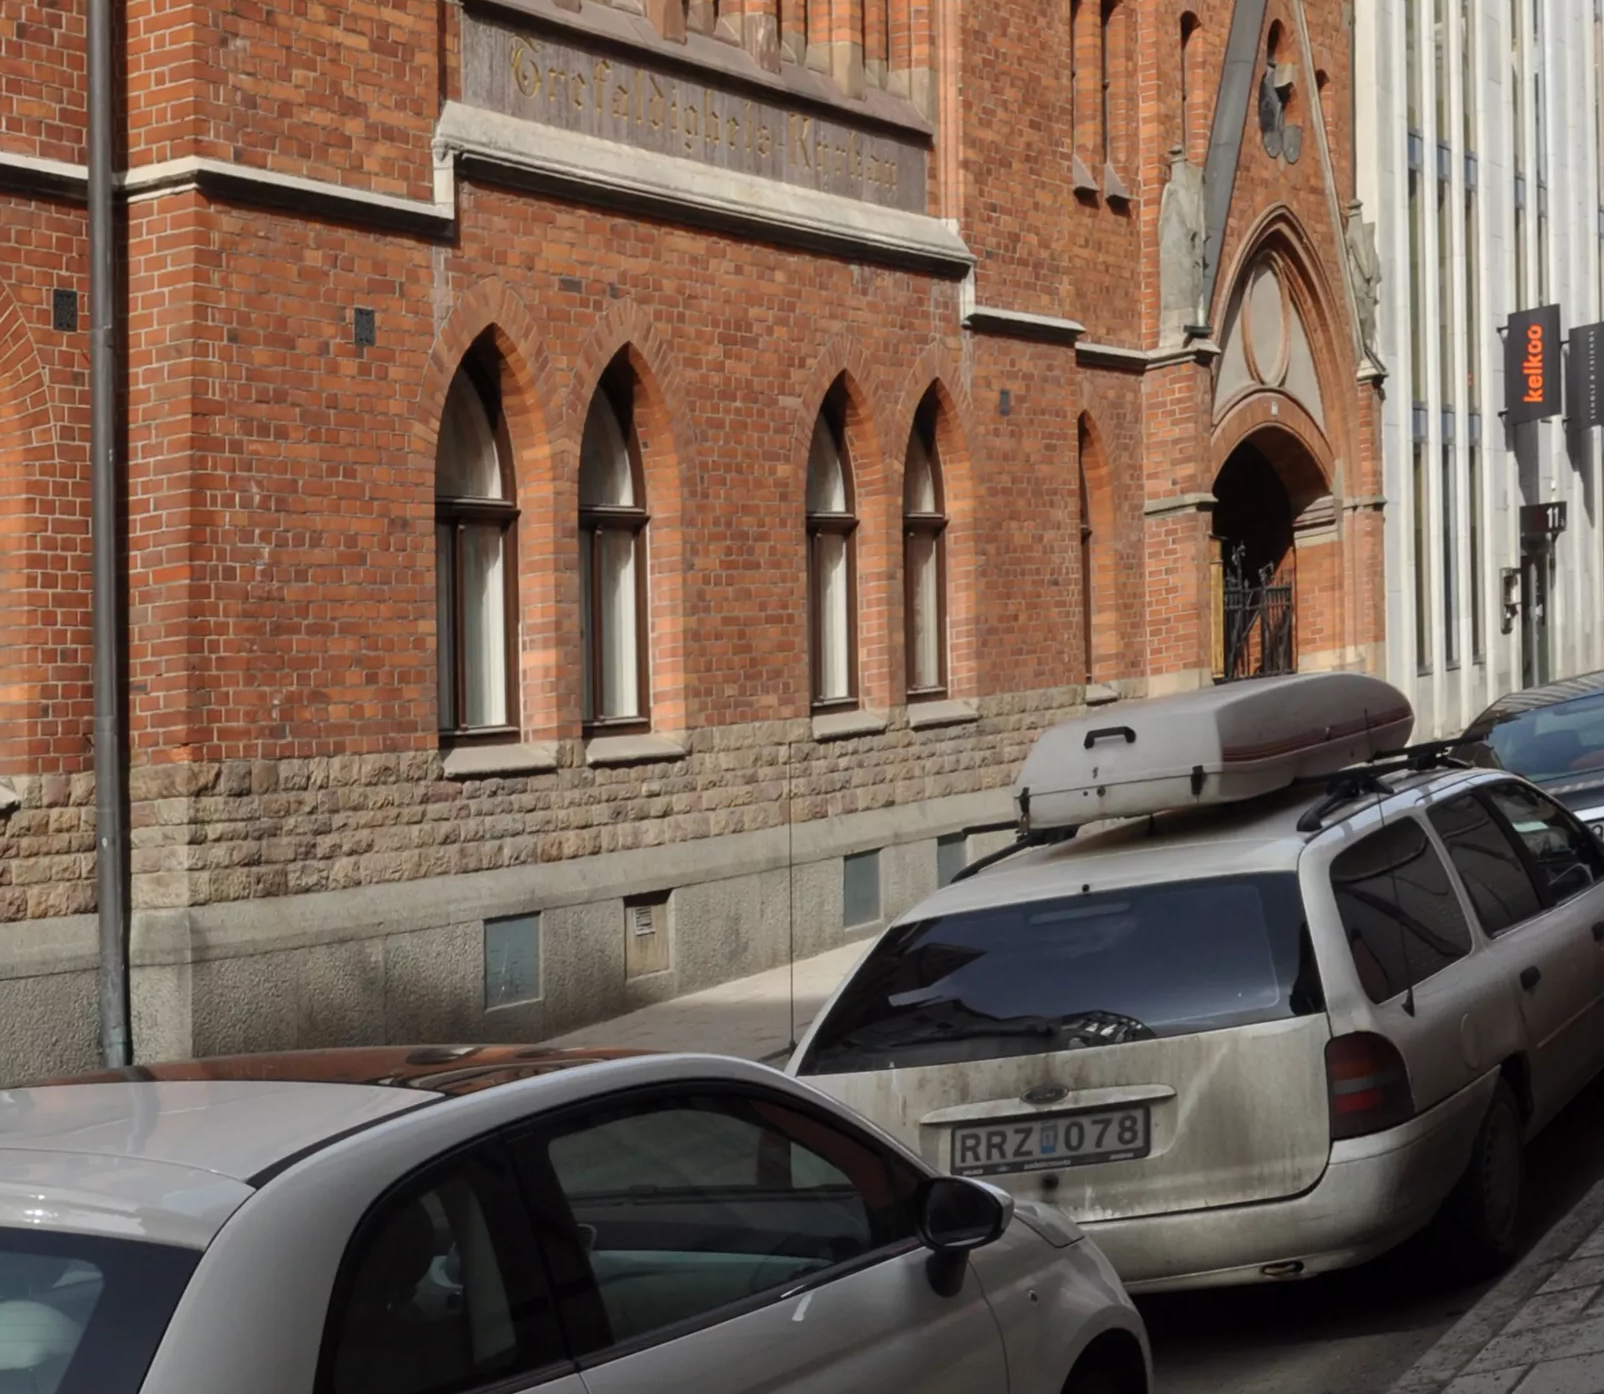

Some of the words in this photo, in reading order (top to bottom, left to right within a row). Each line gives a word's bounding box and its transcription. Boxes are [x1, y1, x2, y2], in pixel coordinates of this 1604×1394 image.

[1523, 324, 1543, 403] kelkoo
[960, 1126, 1034, 1164] RRZ
[1064, 1114, 1139, 1153] 078
